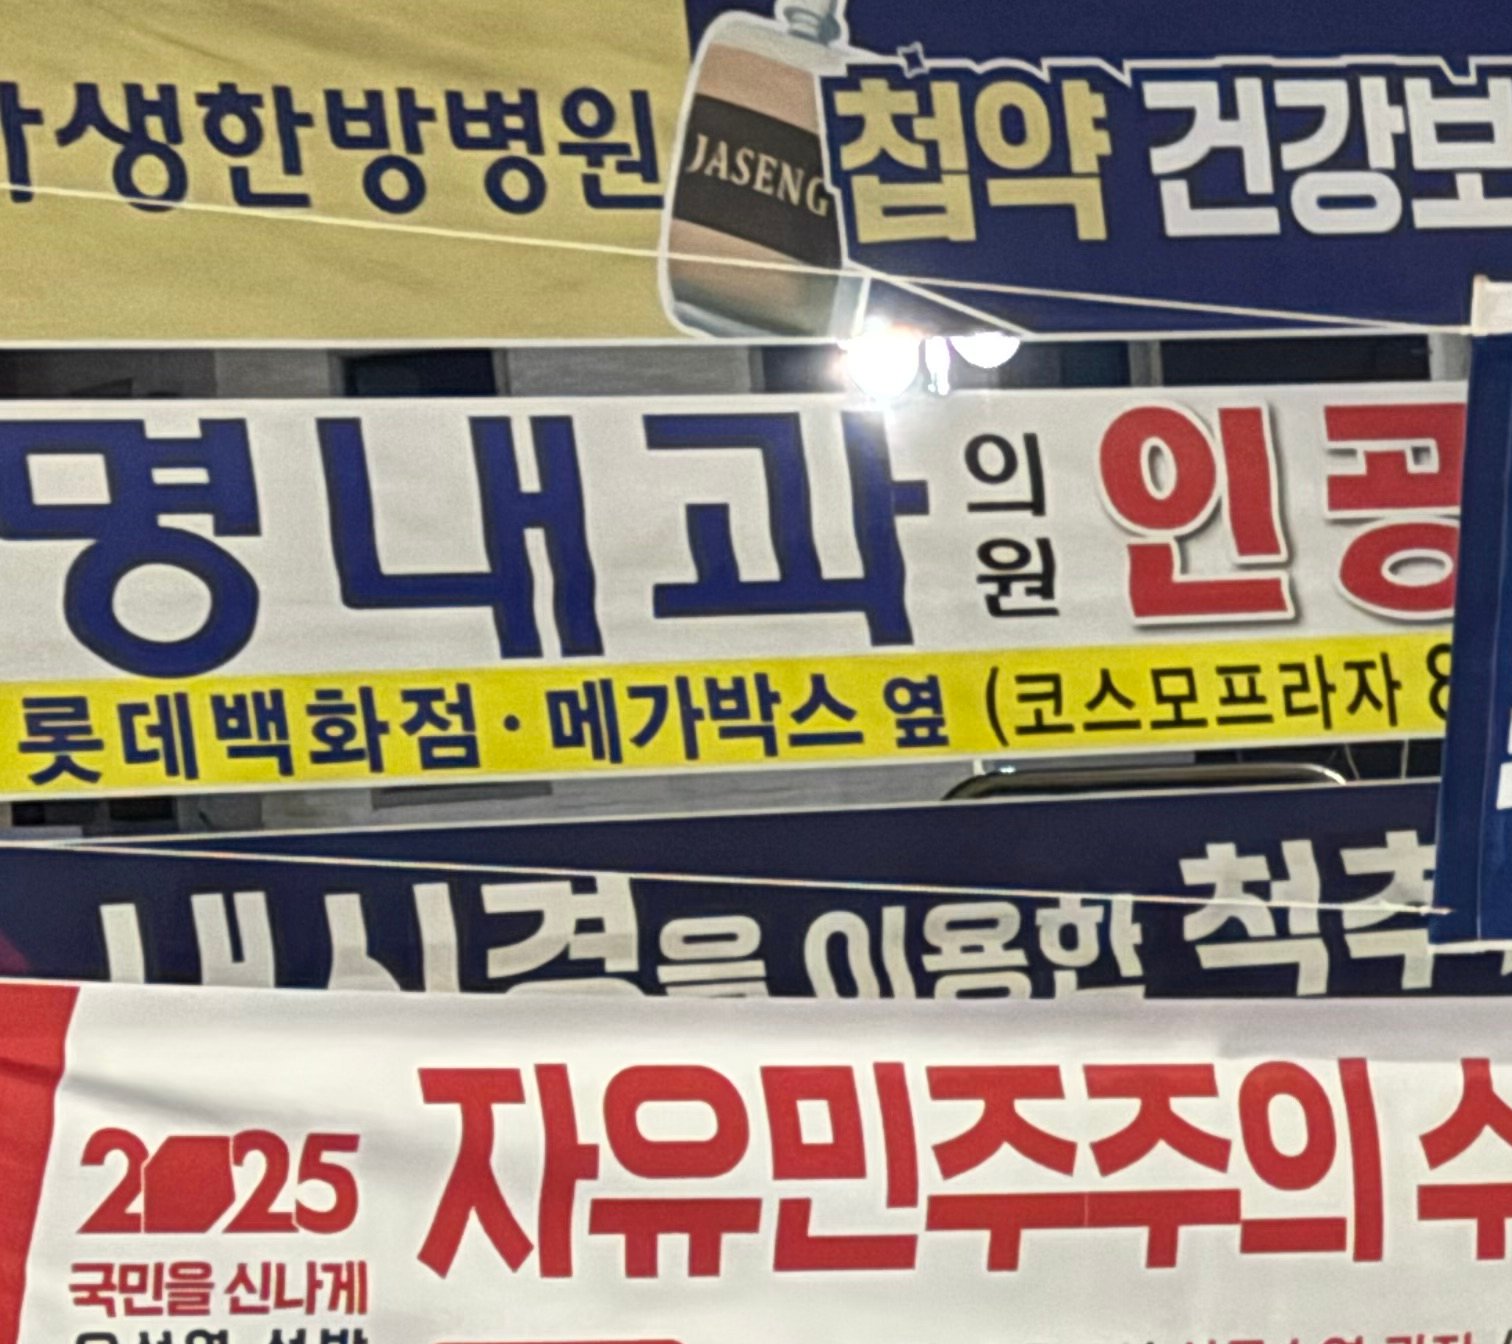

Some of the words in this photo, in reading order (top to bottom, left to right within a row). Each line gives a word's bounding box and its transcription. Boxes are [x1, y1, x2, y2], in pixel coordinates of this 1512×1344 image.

[686, 134, 829, 217] JASENG
[833, 77, 1112, 243] 첩약
[883, 675, 950, 749] 옆
[985, 652, 1402, 746] (코스모프라자
[416, 1058, 1384, 1279] 자유민주주의
[69, 1260, 215, 1318] 국민을
[224, 1260, 368, 1315] 신나게
